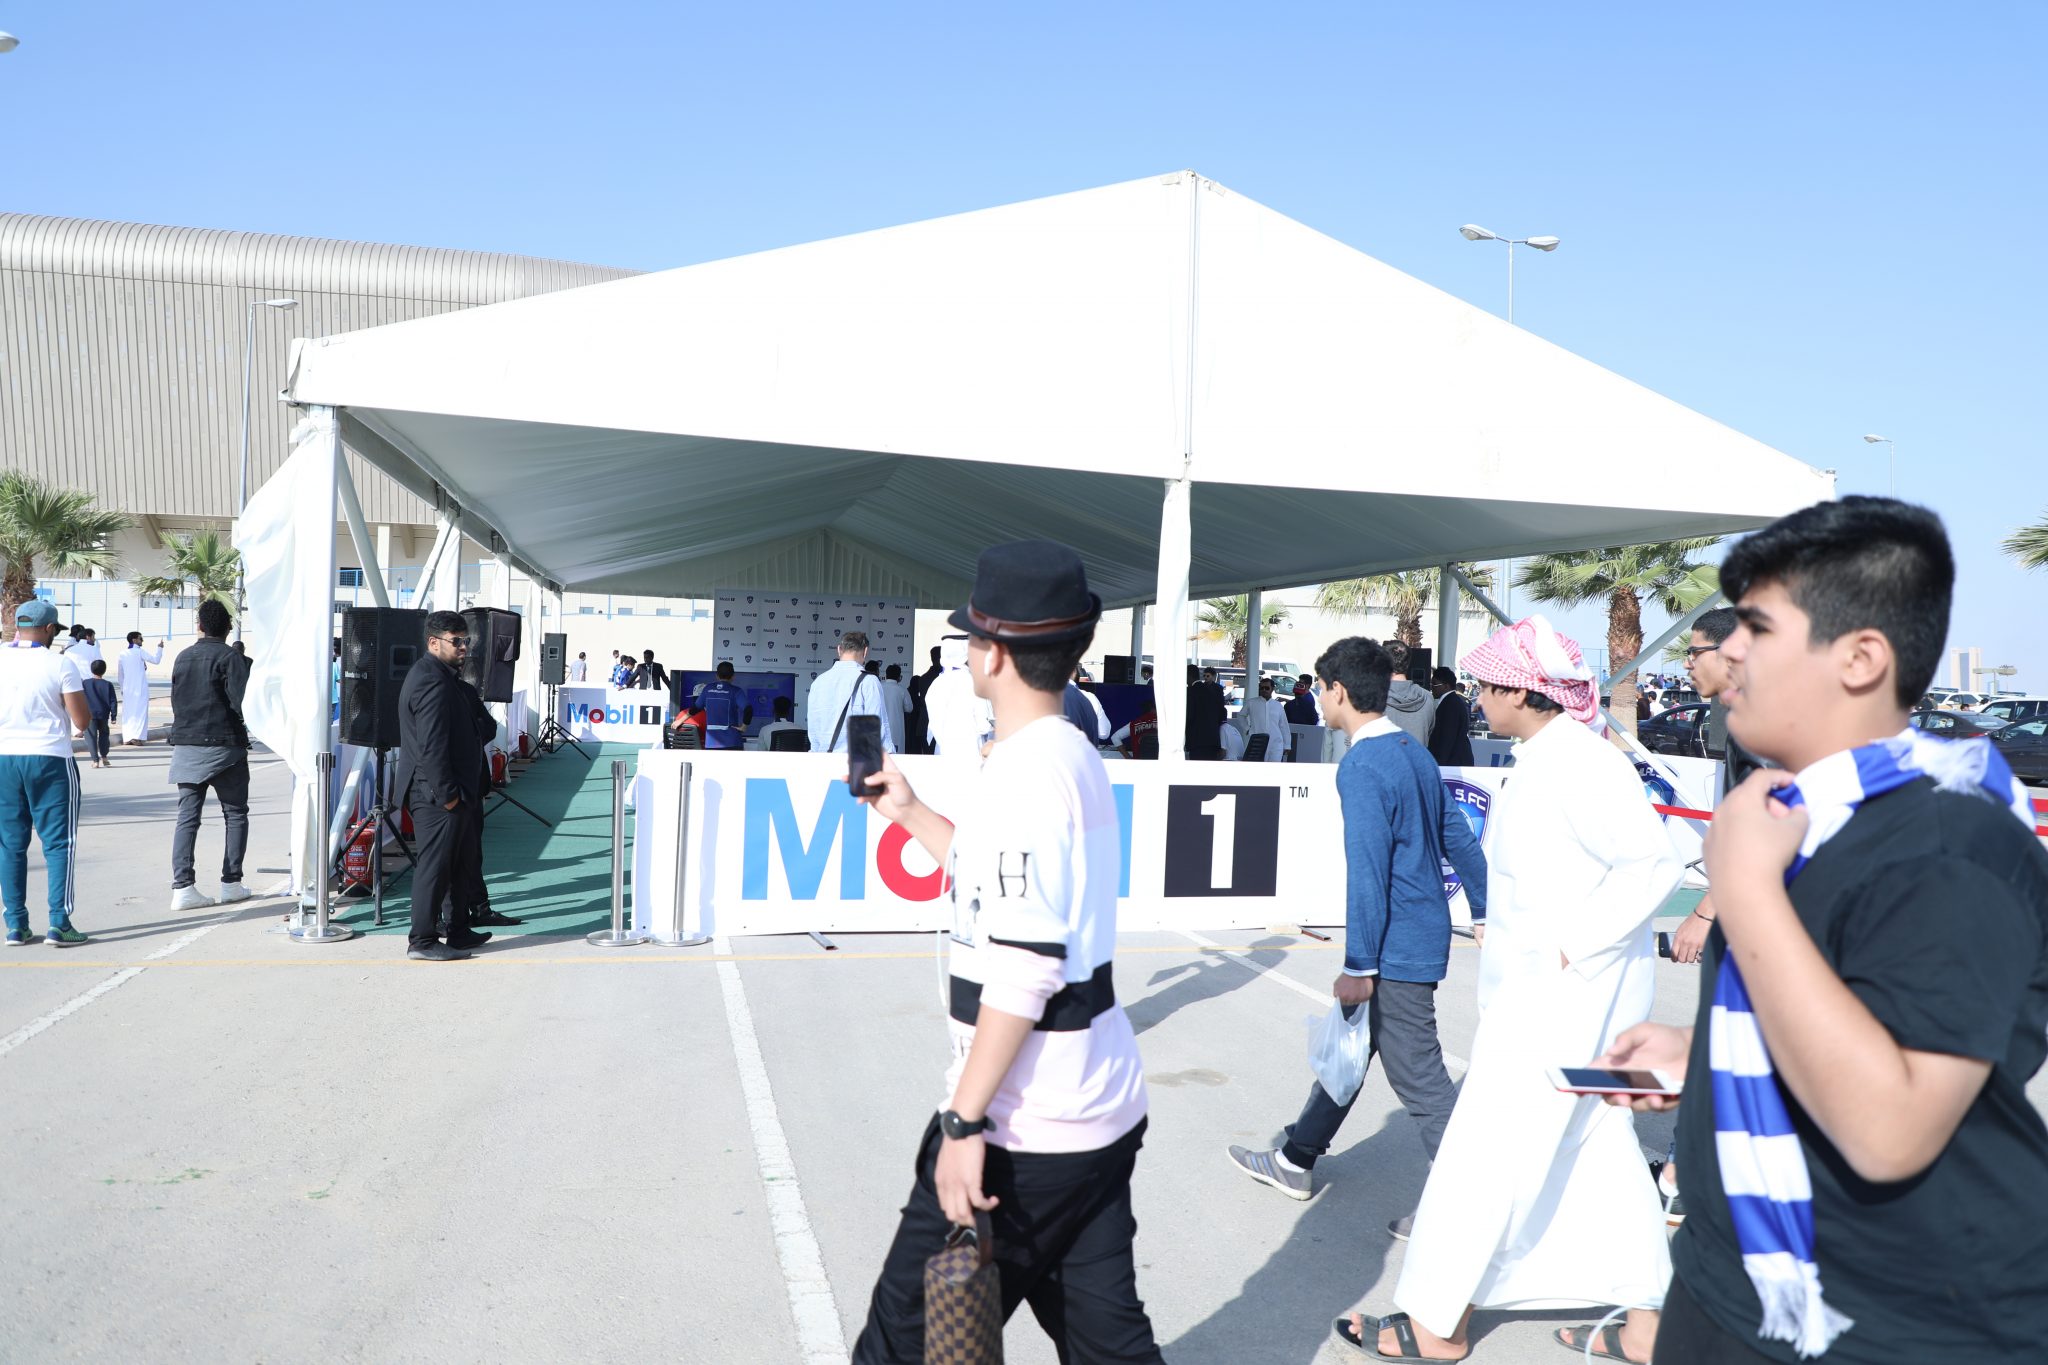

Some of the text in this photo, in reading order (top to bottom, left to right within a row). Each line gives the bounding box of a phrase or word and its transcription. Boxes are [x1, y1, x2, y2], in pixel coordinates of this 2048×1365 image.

[567, 703, 634, 724] Mobil
[742, 778, 1133, 901] Mol
[1289, 786, 1309, 798] TM
